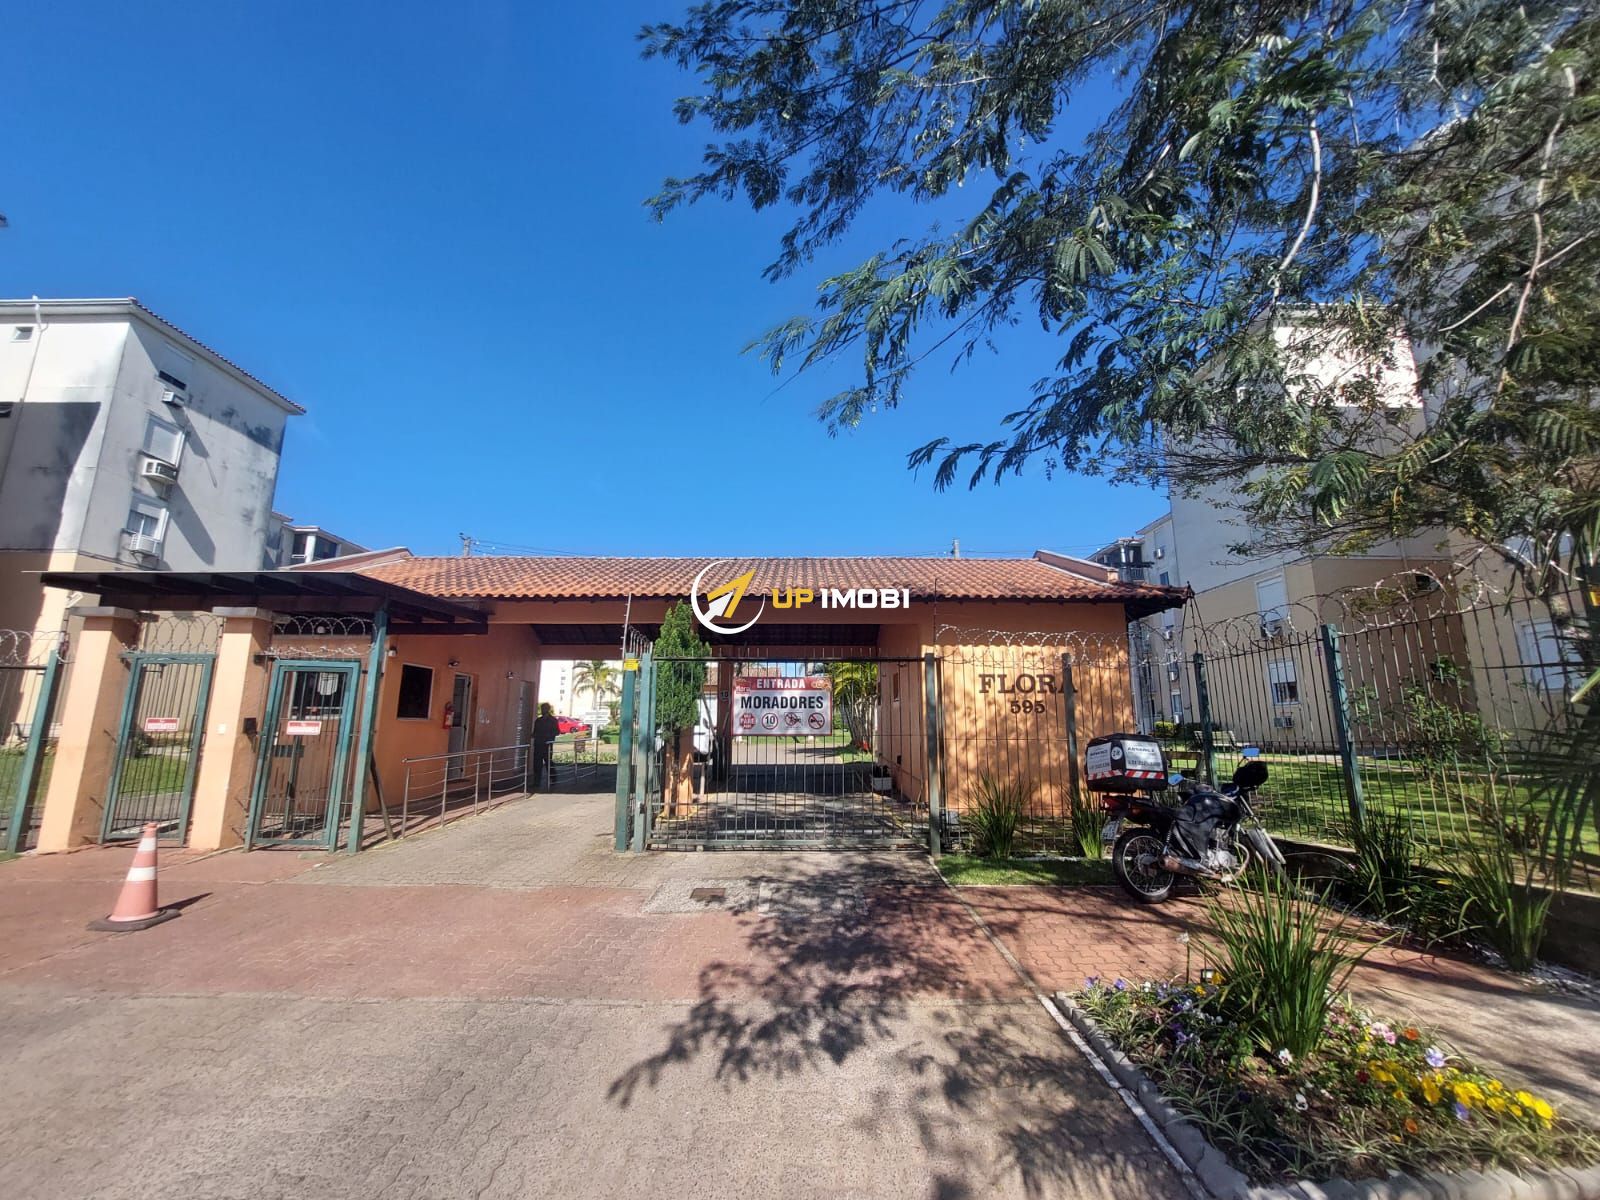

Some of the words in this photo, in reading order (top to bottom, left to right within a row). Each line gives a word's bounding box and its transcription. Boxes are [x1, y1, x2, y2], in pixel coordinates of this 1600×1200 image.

[756, 679, 805, 689] ENTRADA
[741, 696, 823, 709] MORADORES
[1009, 700, 1046, 714] 595
[765, 716, 775, 724] 10
